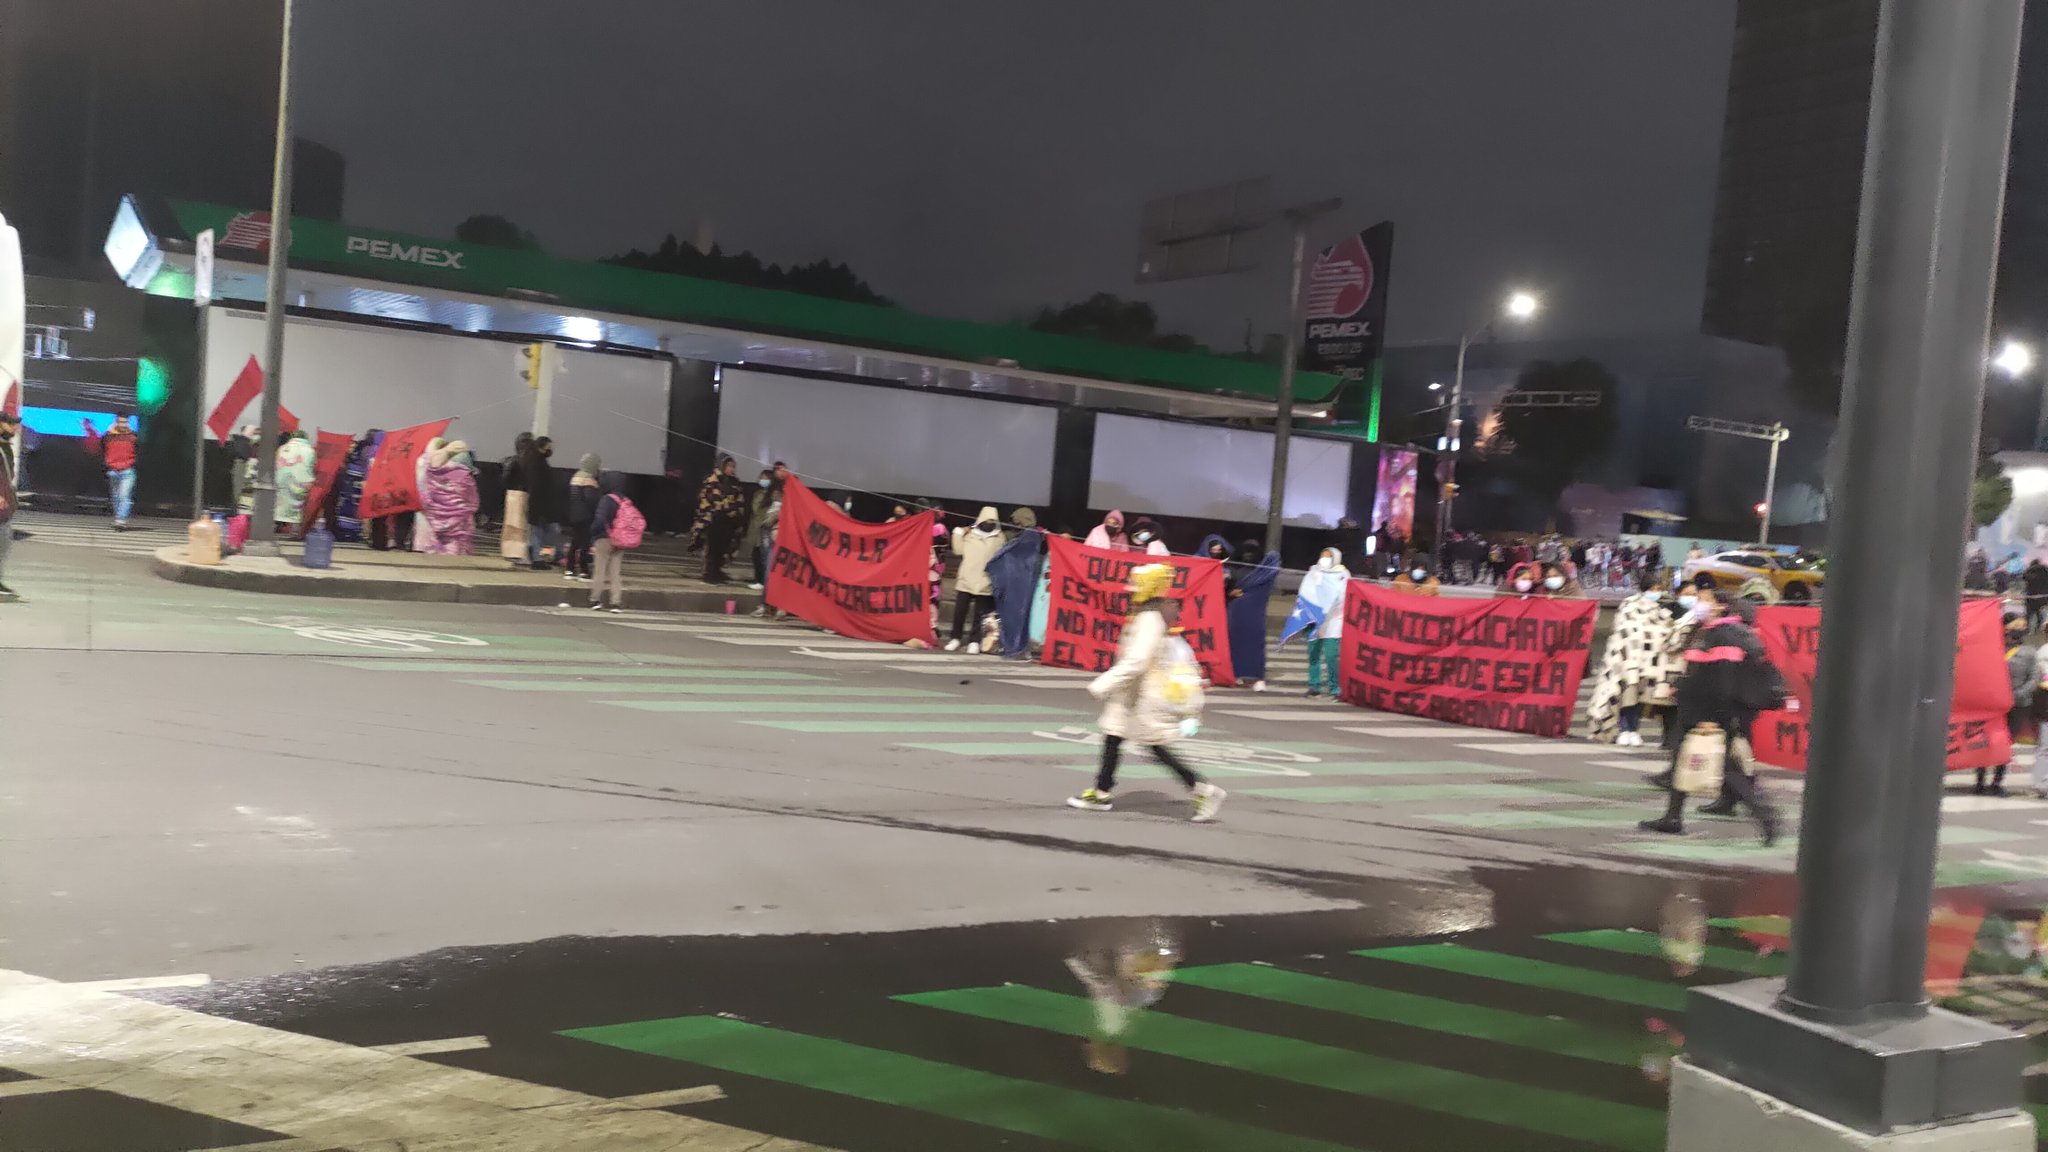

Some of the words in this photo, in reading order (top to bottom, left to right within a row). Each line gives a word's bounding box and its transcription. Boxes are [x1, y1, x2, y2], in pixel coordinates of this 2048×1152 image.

[347, 236, 465, 269] PEMEX
[1308, 321, 1373, 339] PEMEX
[808, 520, 832, 550] NO
[837, 532, 852, 558] A
[857, 537, 889, 563] LA
[1055, 608, 1086, 635] NO
[1193, 594, 1208, 619] Y
[1346, 592, 1372, 633] LA
[1456, 614, 1538, 651] LUCHA
[1542, 616, 1591, 656] QUE
[1053, 640, 1083, 669] EL
[1356, 641, 1388, 678] SE
[1388, 651, 1490, 691] PIERDE
[1492, 661, 1531, 693] ES
[1532, 662, 1569, 695] LA
